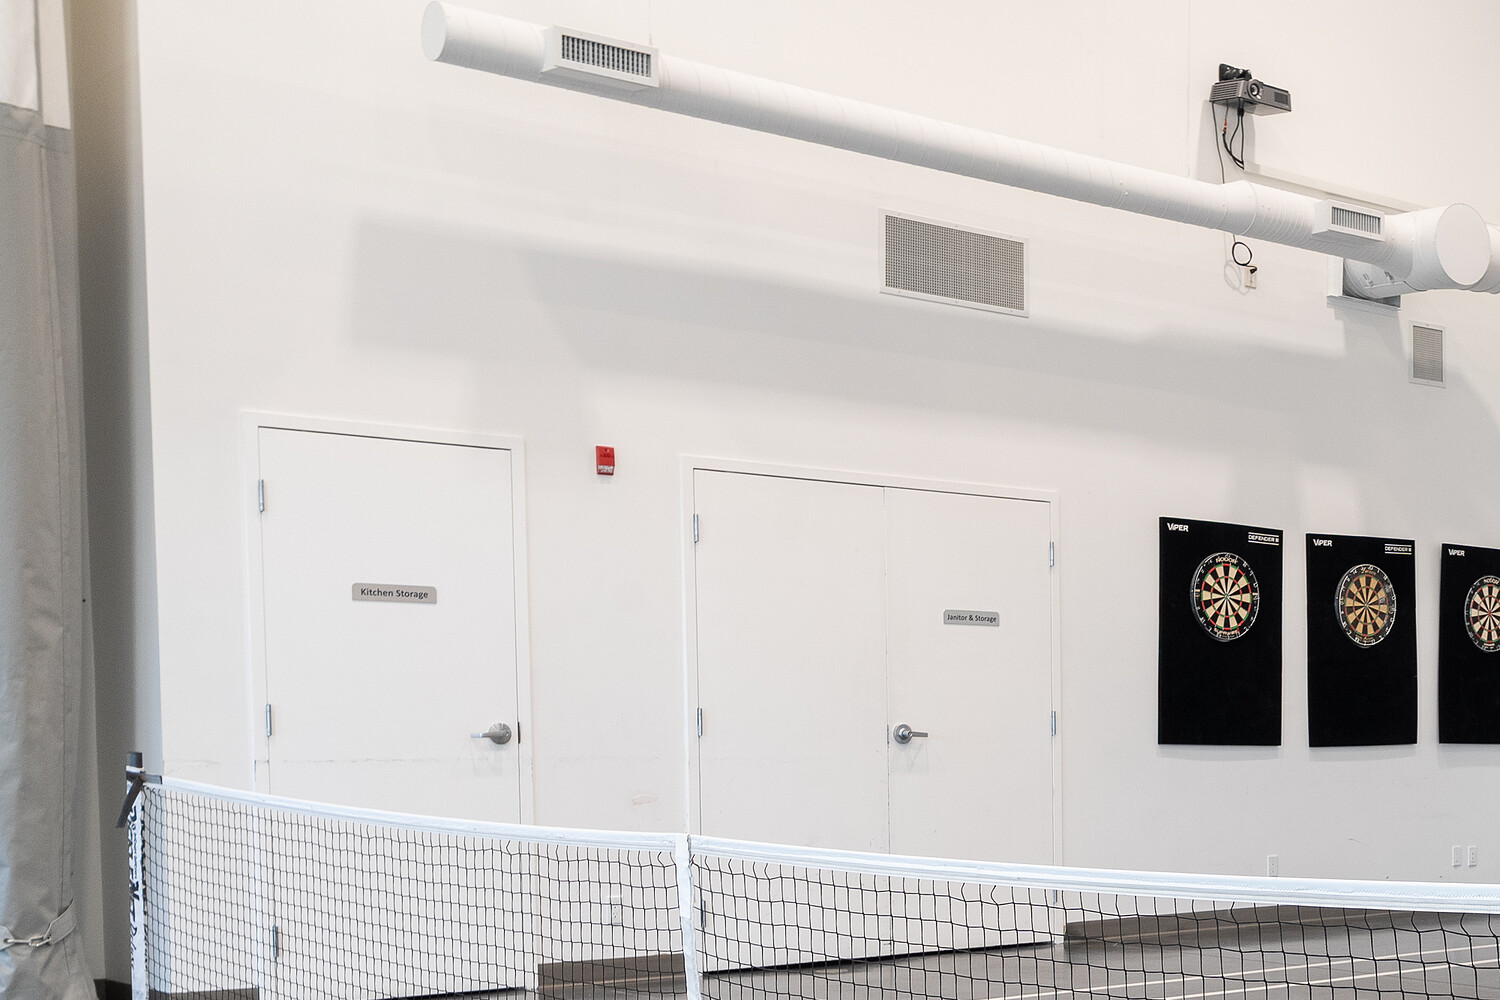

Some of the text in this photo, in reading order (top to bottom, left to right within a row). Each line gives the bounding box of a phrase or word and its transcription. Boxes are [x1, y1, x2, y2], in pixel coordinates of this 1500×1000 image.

[1166, 522, 1189, 532] VIPER
[1248, 534, 1274, 543] DEFENDER
[1313, 538, 1333, 547] VIPER
[1448, 548, 1465, 557] VIPER
[360, 588, 428, 600] Kitchen Storage
[947, 613, 968, 621] Janitor
[975, 614, 997, 624] Storage
